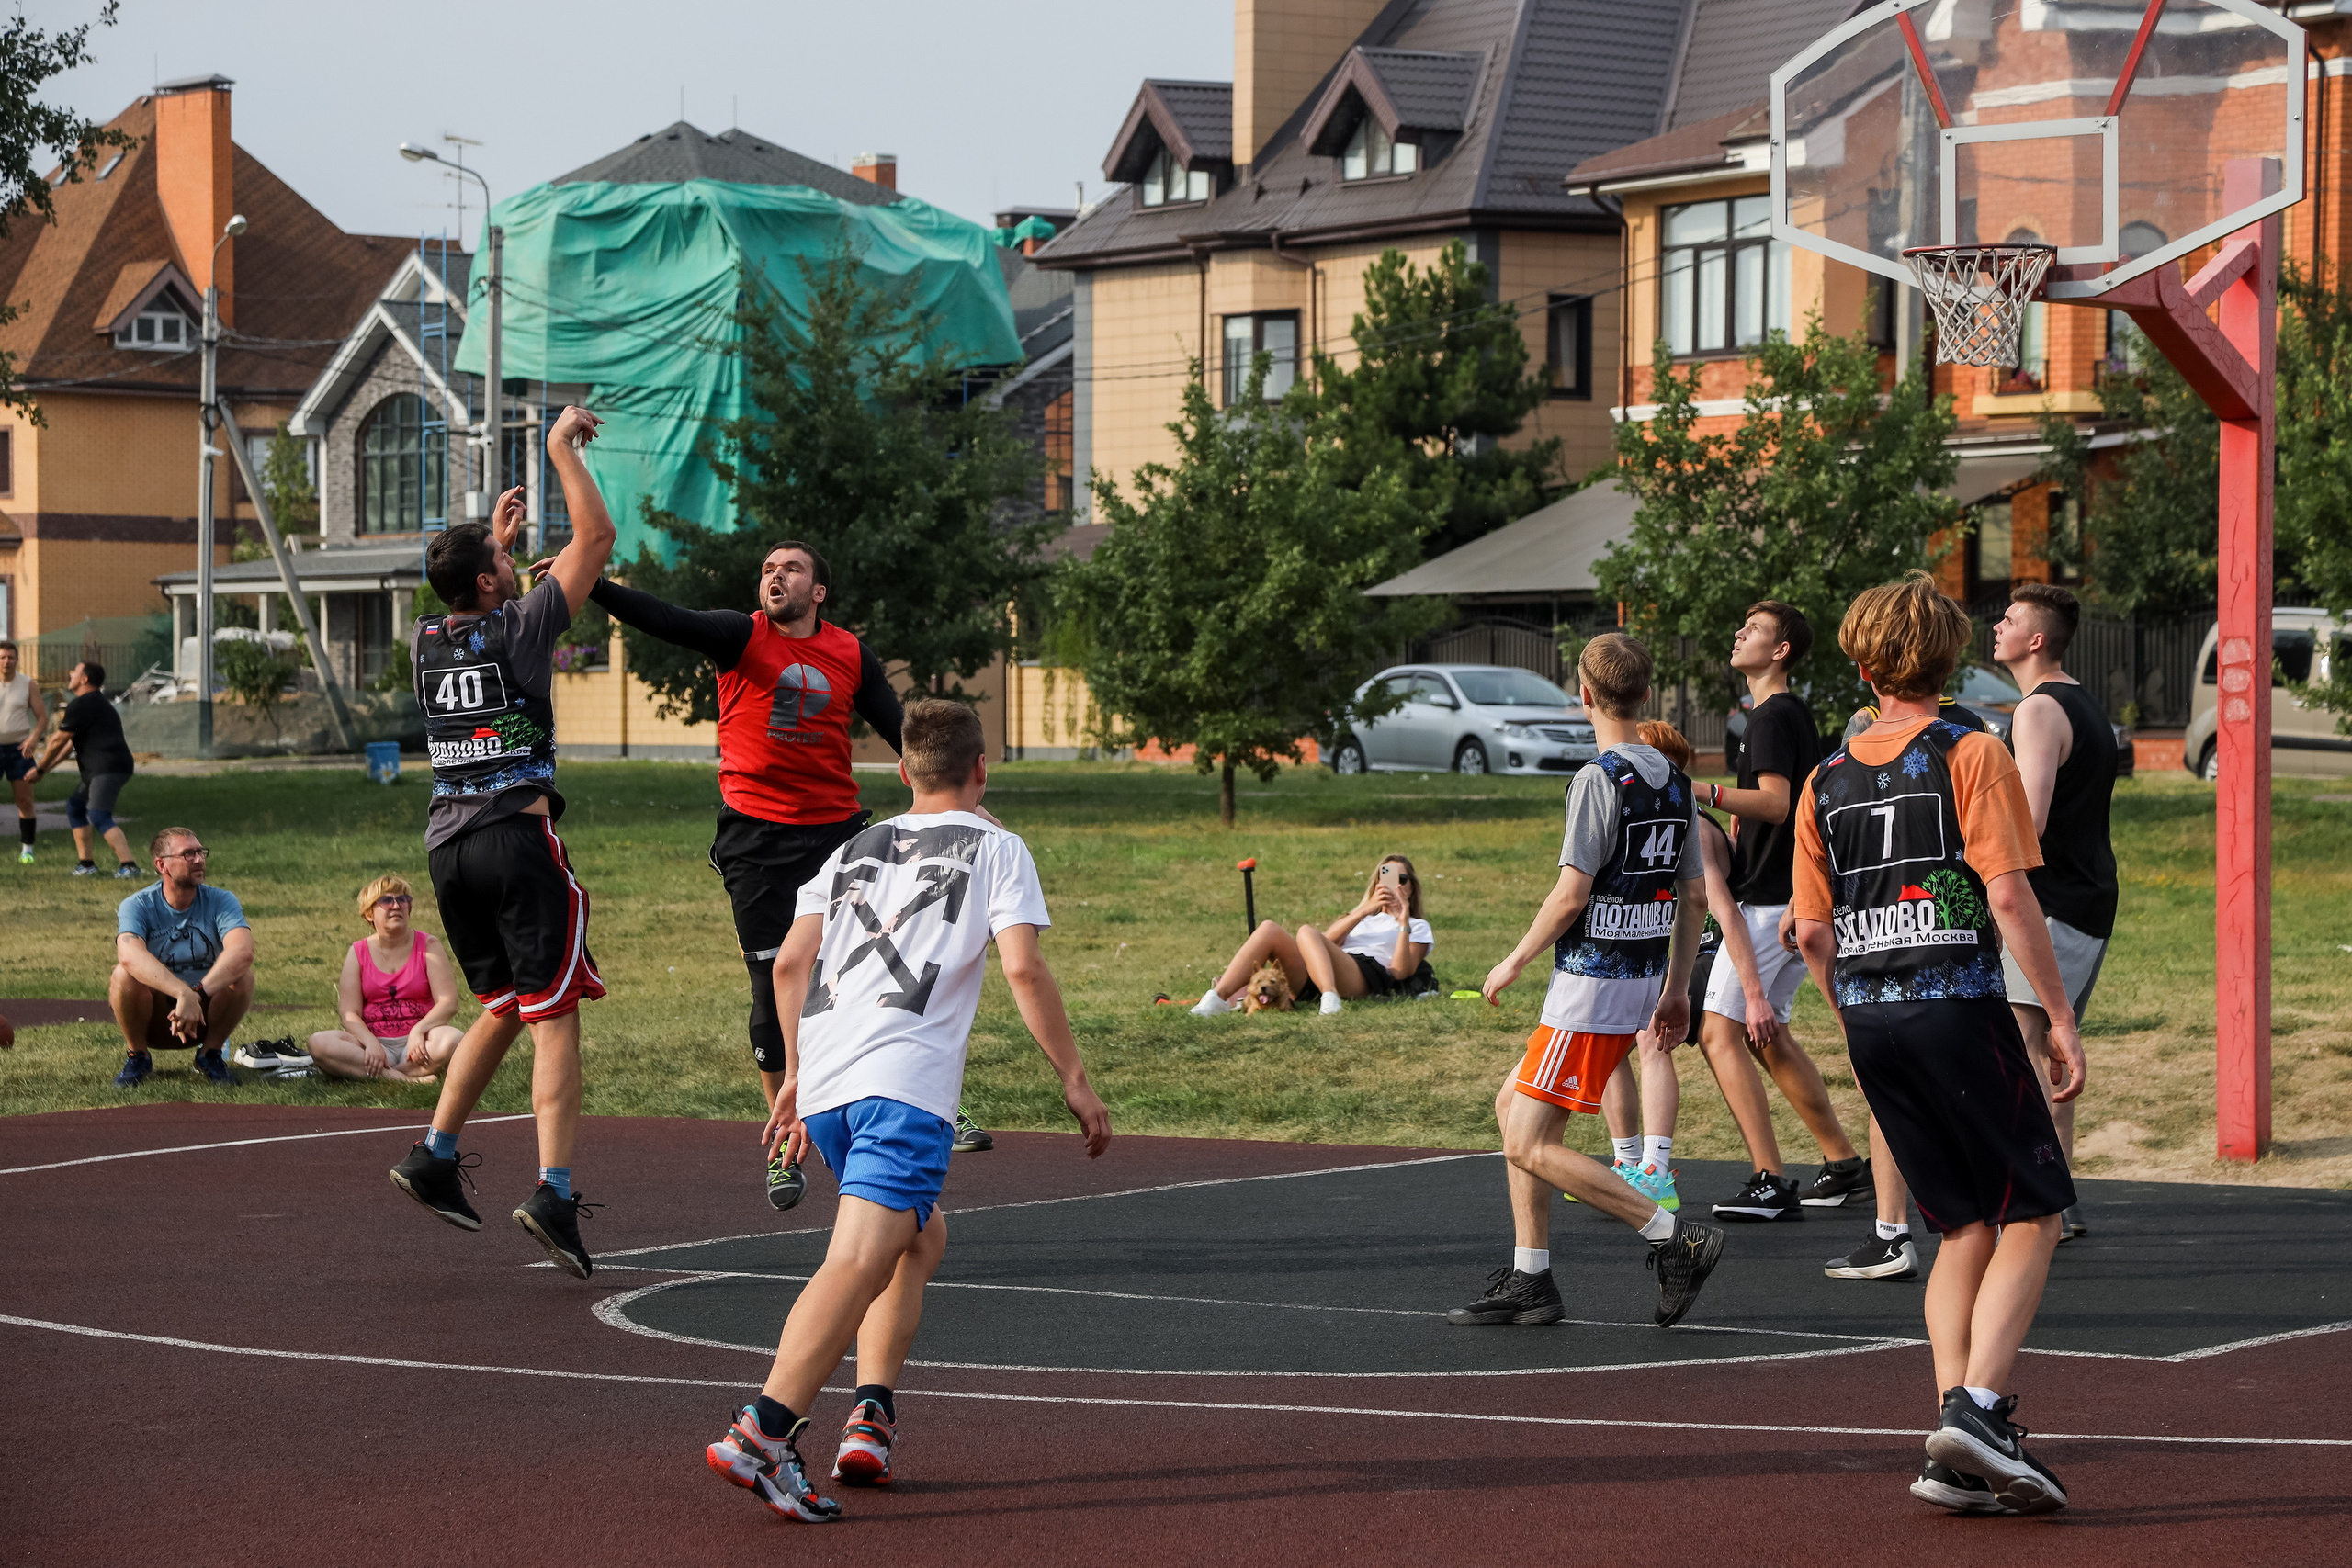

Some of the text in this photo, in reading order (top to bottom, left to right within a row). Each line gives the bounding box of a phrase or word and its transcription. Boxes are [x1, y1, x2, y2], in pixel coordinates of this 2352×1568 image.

[435, 671, 484, 710] 40
[767, 729, 825, 743] PROTEST
[1871, 805, 1895, 860] 7
[1640, 824, 1676, 866] 44
[1596, 893, 1623, 904] посёлок
[1591, 901, 1672, 930] ПОТАПОВО
[1595, 928, 1620, 937] Моя
[1917, 931, 1974, 944] Москва
[1879, 1224, 1897, 1233] PUMA
